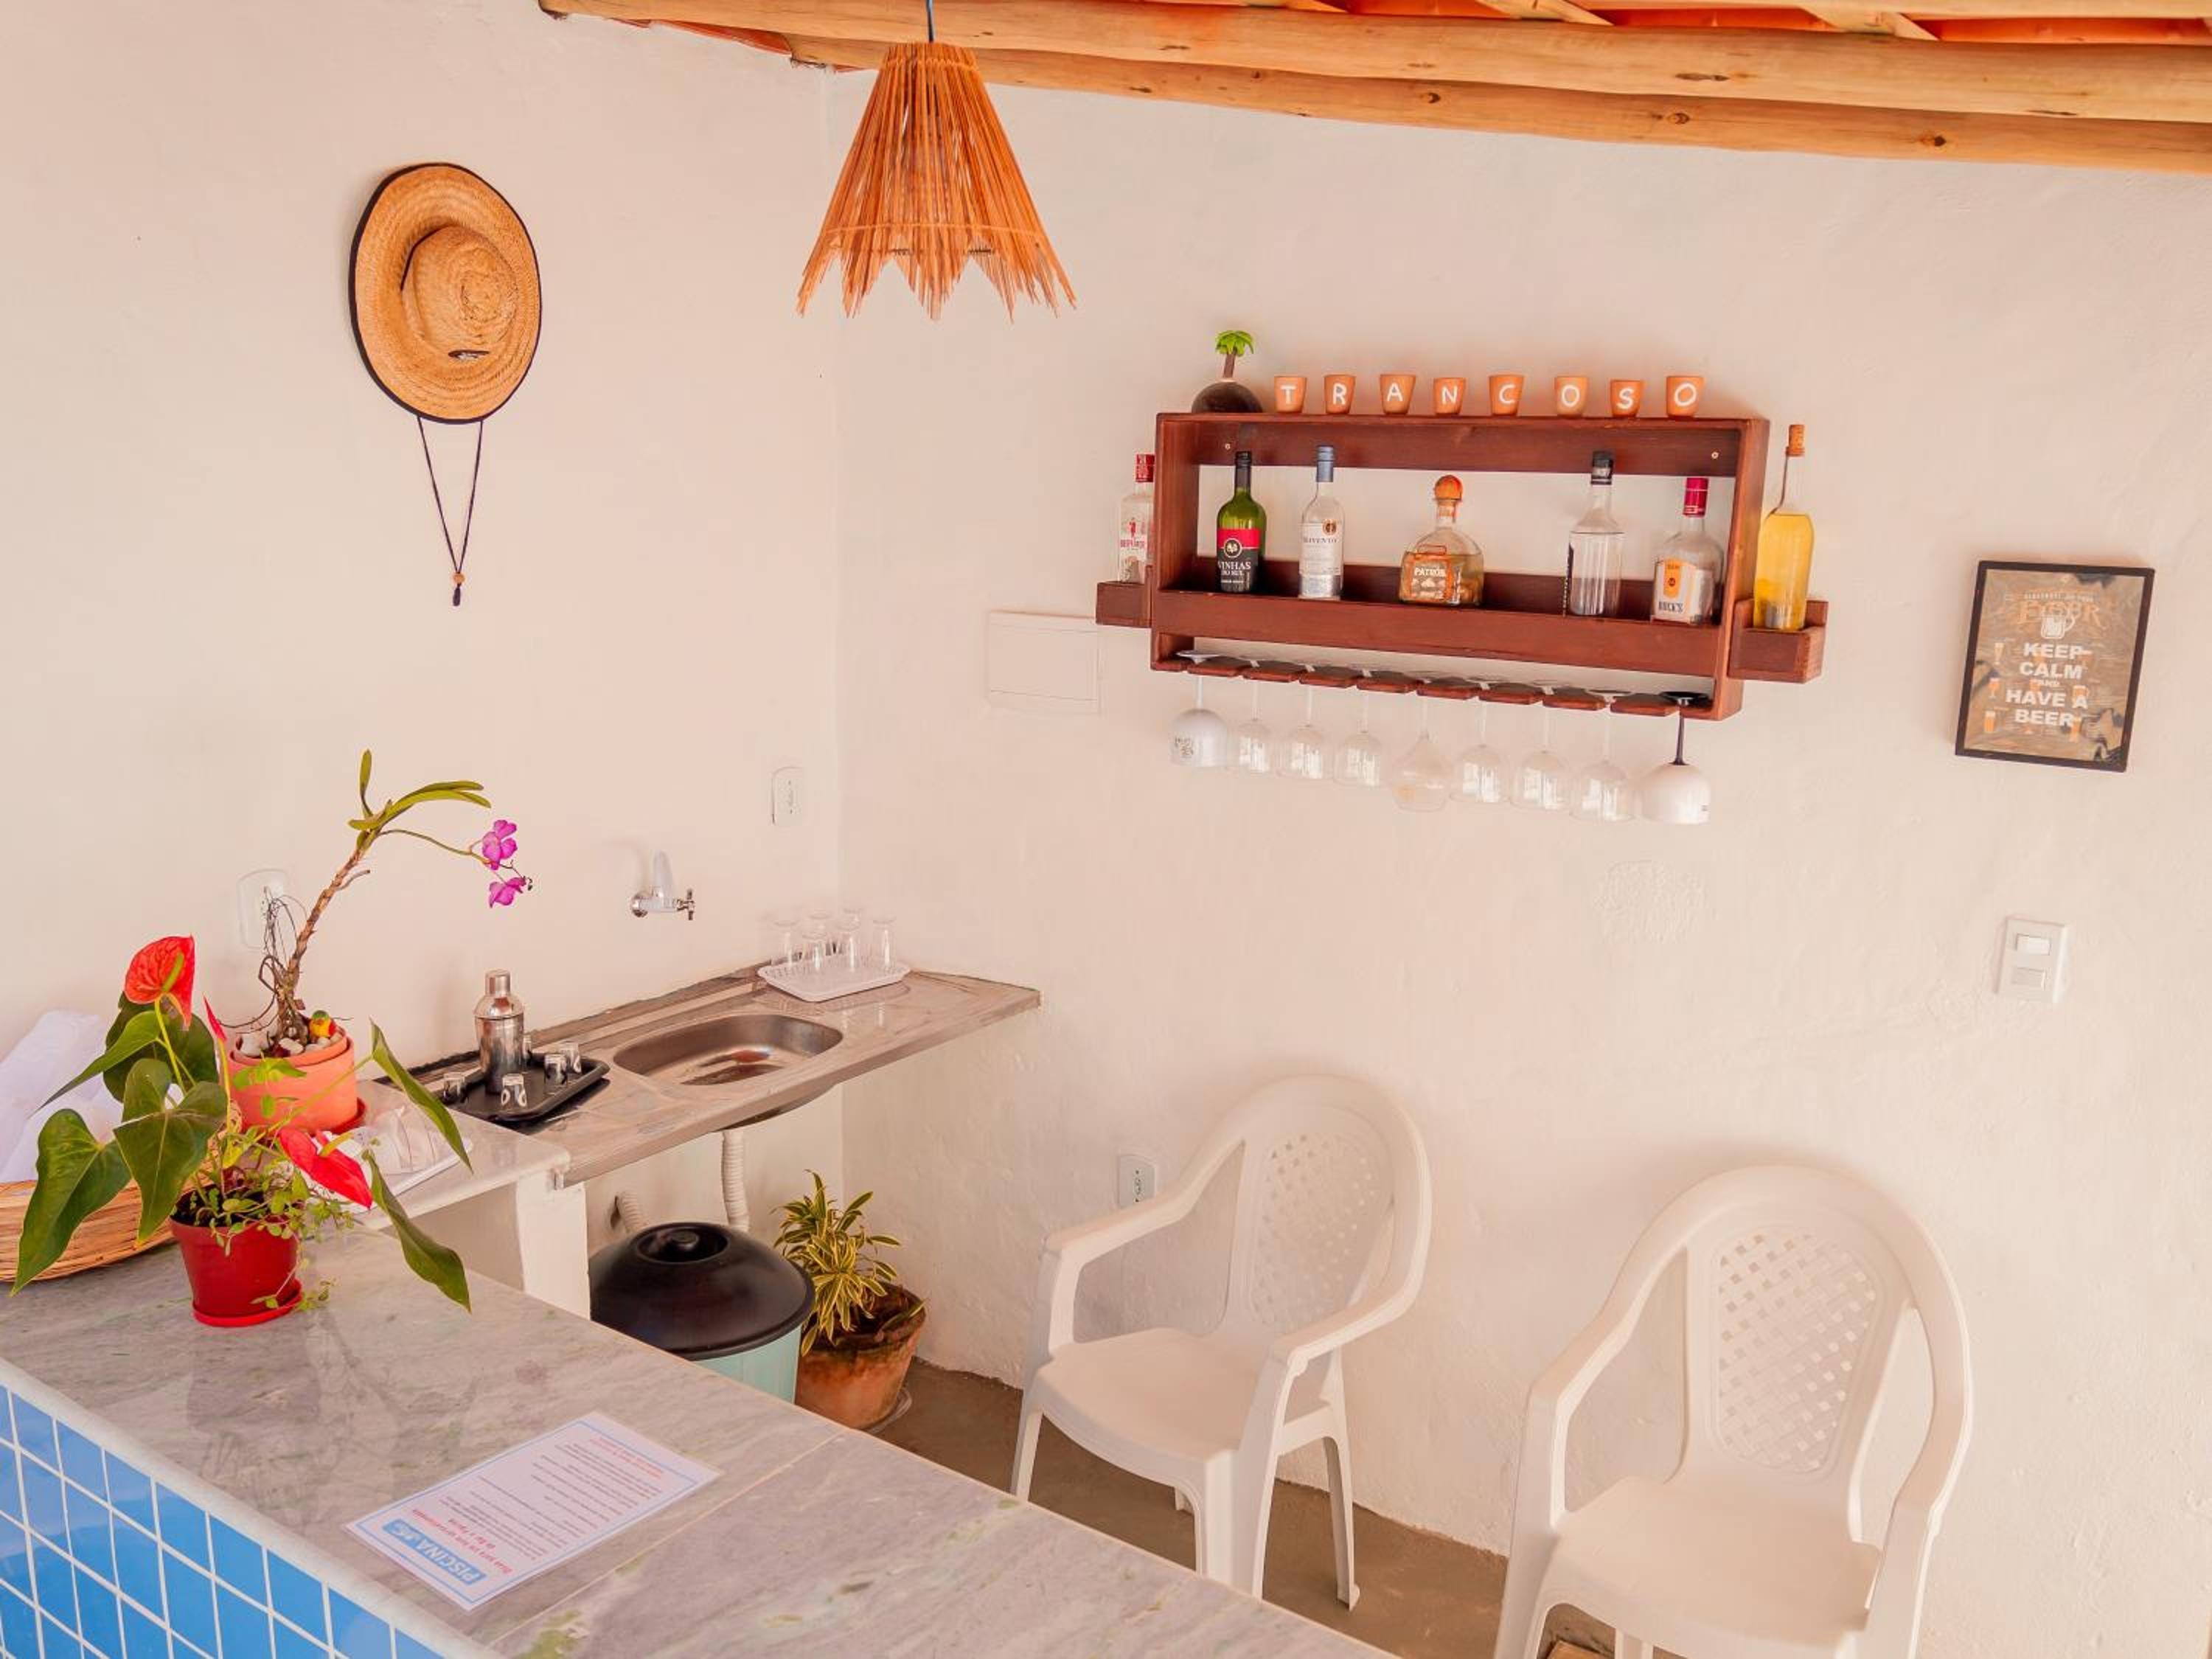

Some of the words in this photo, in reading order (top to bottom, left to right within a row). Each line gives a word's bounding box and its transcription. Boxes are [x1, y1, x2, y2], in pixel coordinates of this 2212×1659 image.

[2023, 642, 2083, 660] KEEP
[2019, 661, 2083, 679] CALM
[2005, 689, 2067, 707] HAVE
[2072, 695, 2088, 709] A
[2014, 709, 2076, 727] BEER
[415, 1537, 477, 1582] PISCINA
